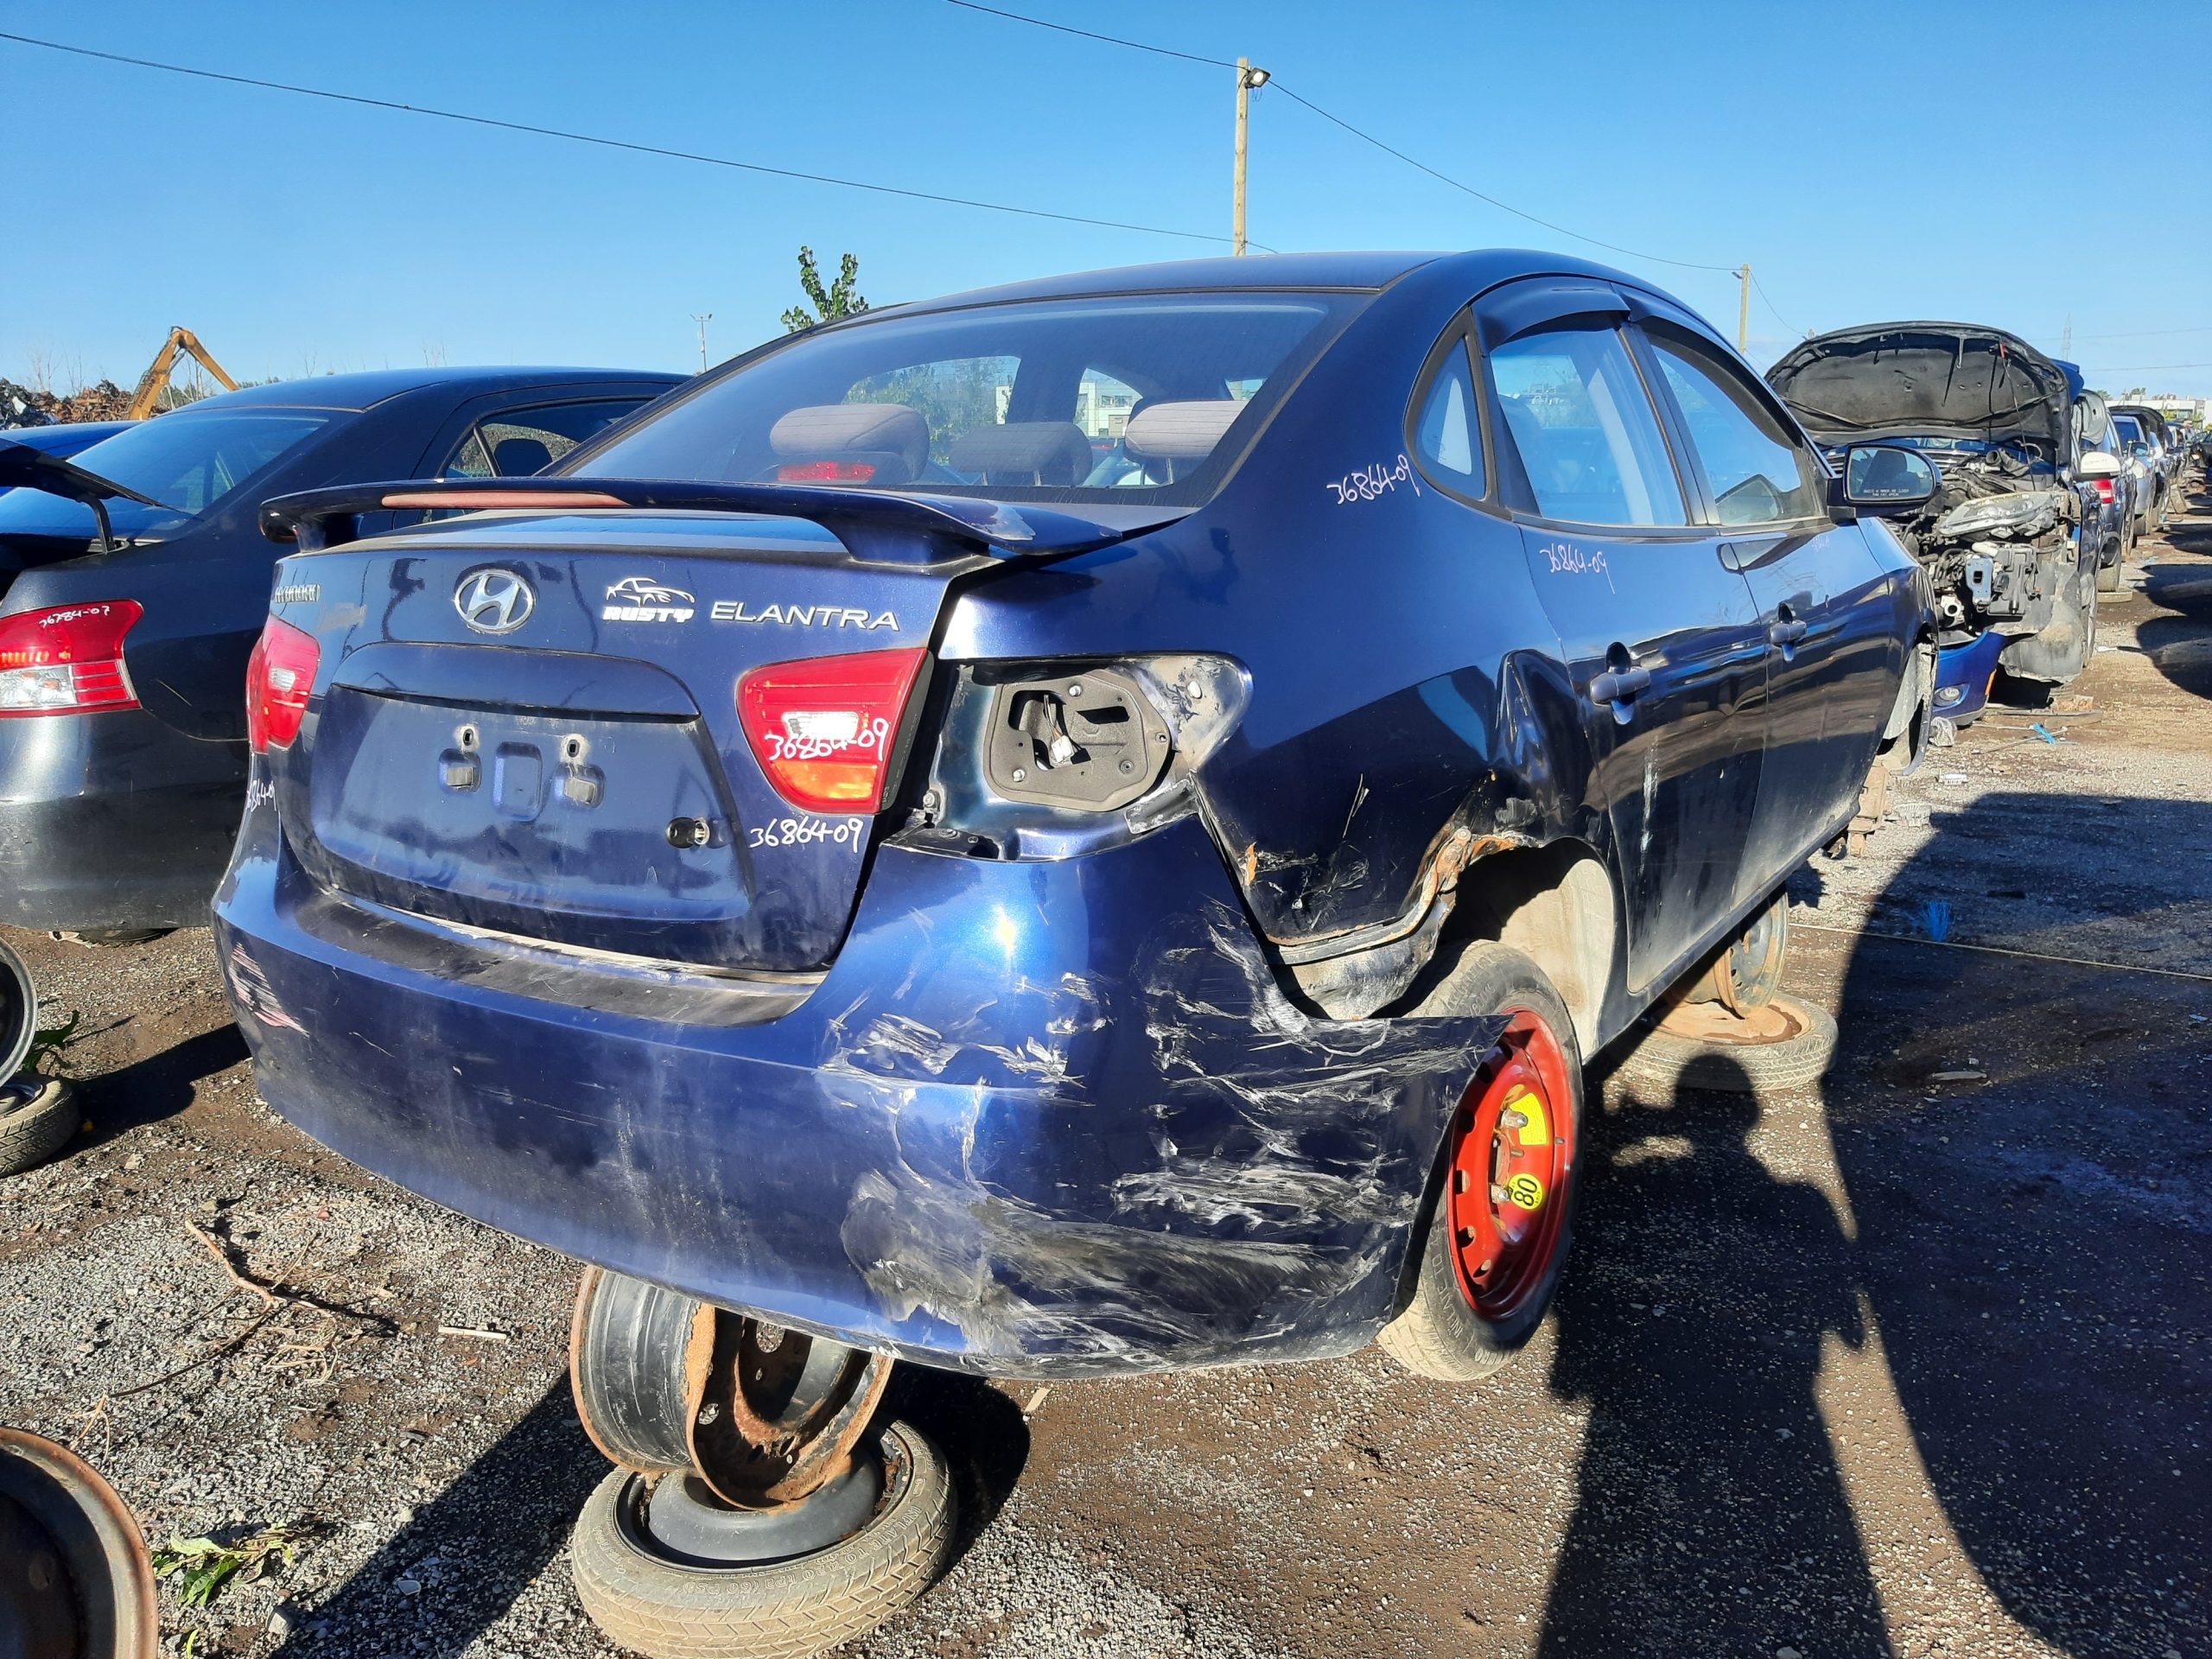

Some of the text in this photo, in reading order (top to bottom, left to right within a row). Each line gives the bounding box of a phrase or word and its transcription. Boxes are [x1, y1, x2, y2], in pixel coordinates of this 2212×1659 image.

[1326, 454, 1421, 505] 36864-09
[602, 607, 695, 623] RUSTY
[709, 601, 900, 632] ELANTRA
[1513, 1177, 1538, 1207] 80
